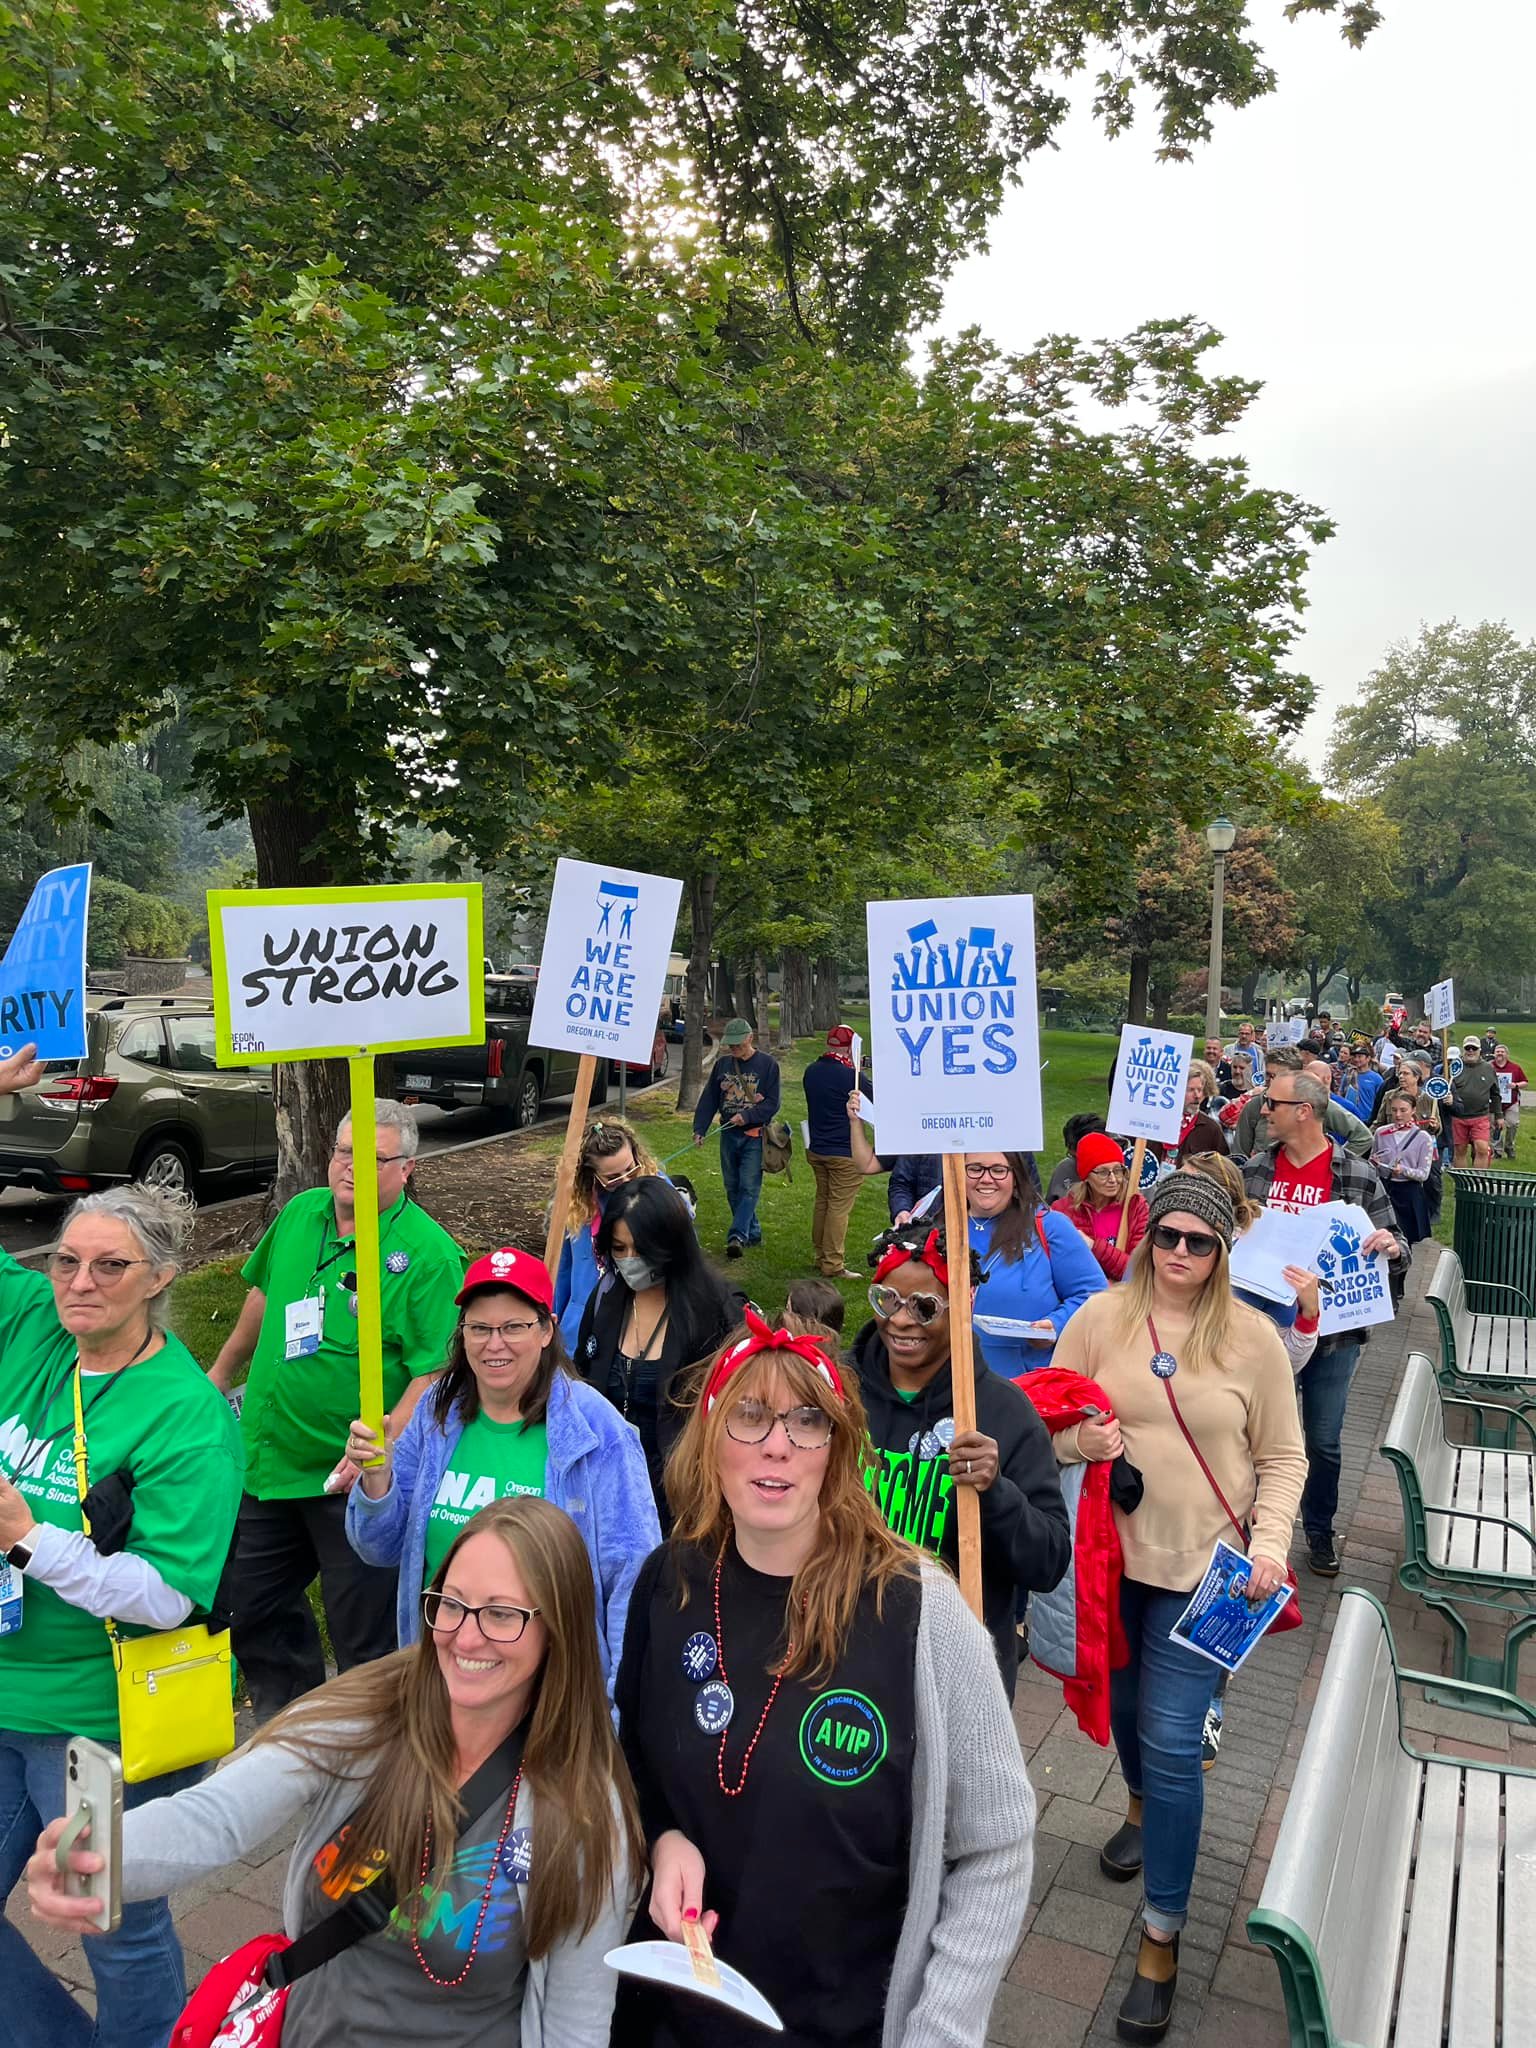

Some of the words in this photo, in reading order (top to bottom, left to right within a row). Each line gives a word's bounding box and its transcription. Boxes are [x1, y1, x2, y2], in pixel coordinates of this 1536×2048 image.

[264, 923, 438, 966] UNION
[585, 937, 633, 969] WE
[242, 960, 459, 1008] STRONG
[571, 965, 636, 999] ARE
[566, 993, 633, 1027] ONE
[891, 990, 1015, 1023] UNION
[566, 1024, 593, 1038] OREGON
[593, 1029, 620, 1042] AFL-CIO
[896, 1023, 1017, 1076] YES
[1126, 1066, 1178, 1086] UNION
[1126, 1079, 1175, 1109] YES
[921, 1117, 957, 1130] OREGON
[959, 1116, 994, 1129] AFL-CIO
[1268, 1180, 1290, 1200] WE
[1291, 1183, 1325, 1205] ARE
[1322, 1285, 1384, 1311] POWER
[46, 1487, 78, 1504] Since
[430, 1508, 441, 1519] of
[703, 1684, 729, 1700] RESPECT
[697, 1703, 709, 1730] LIVING
[710, 1710, 729, 1730] WAGE
[815, 1717, 870, 1755] AVIP
[821, 1763, 858, 1777] PRACTICE
